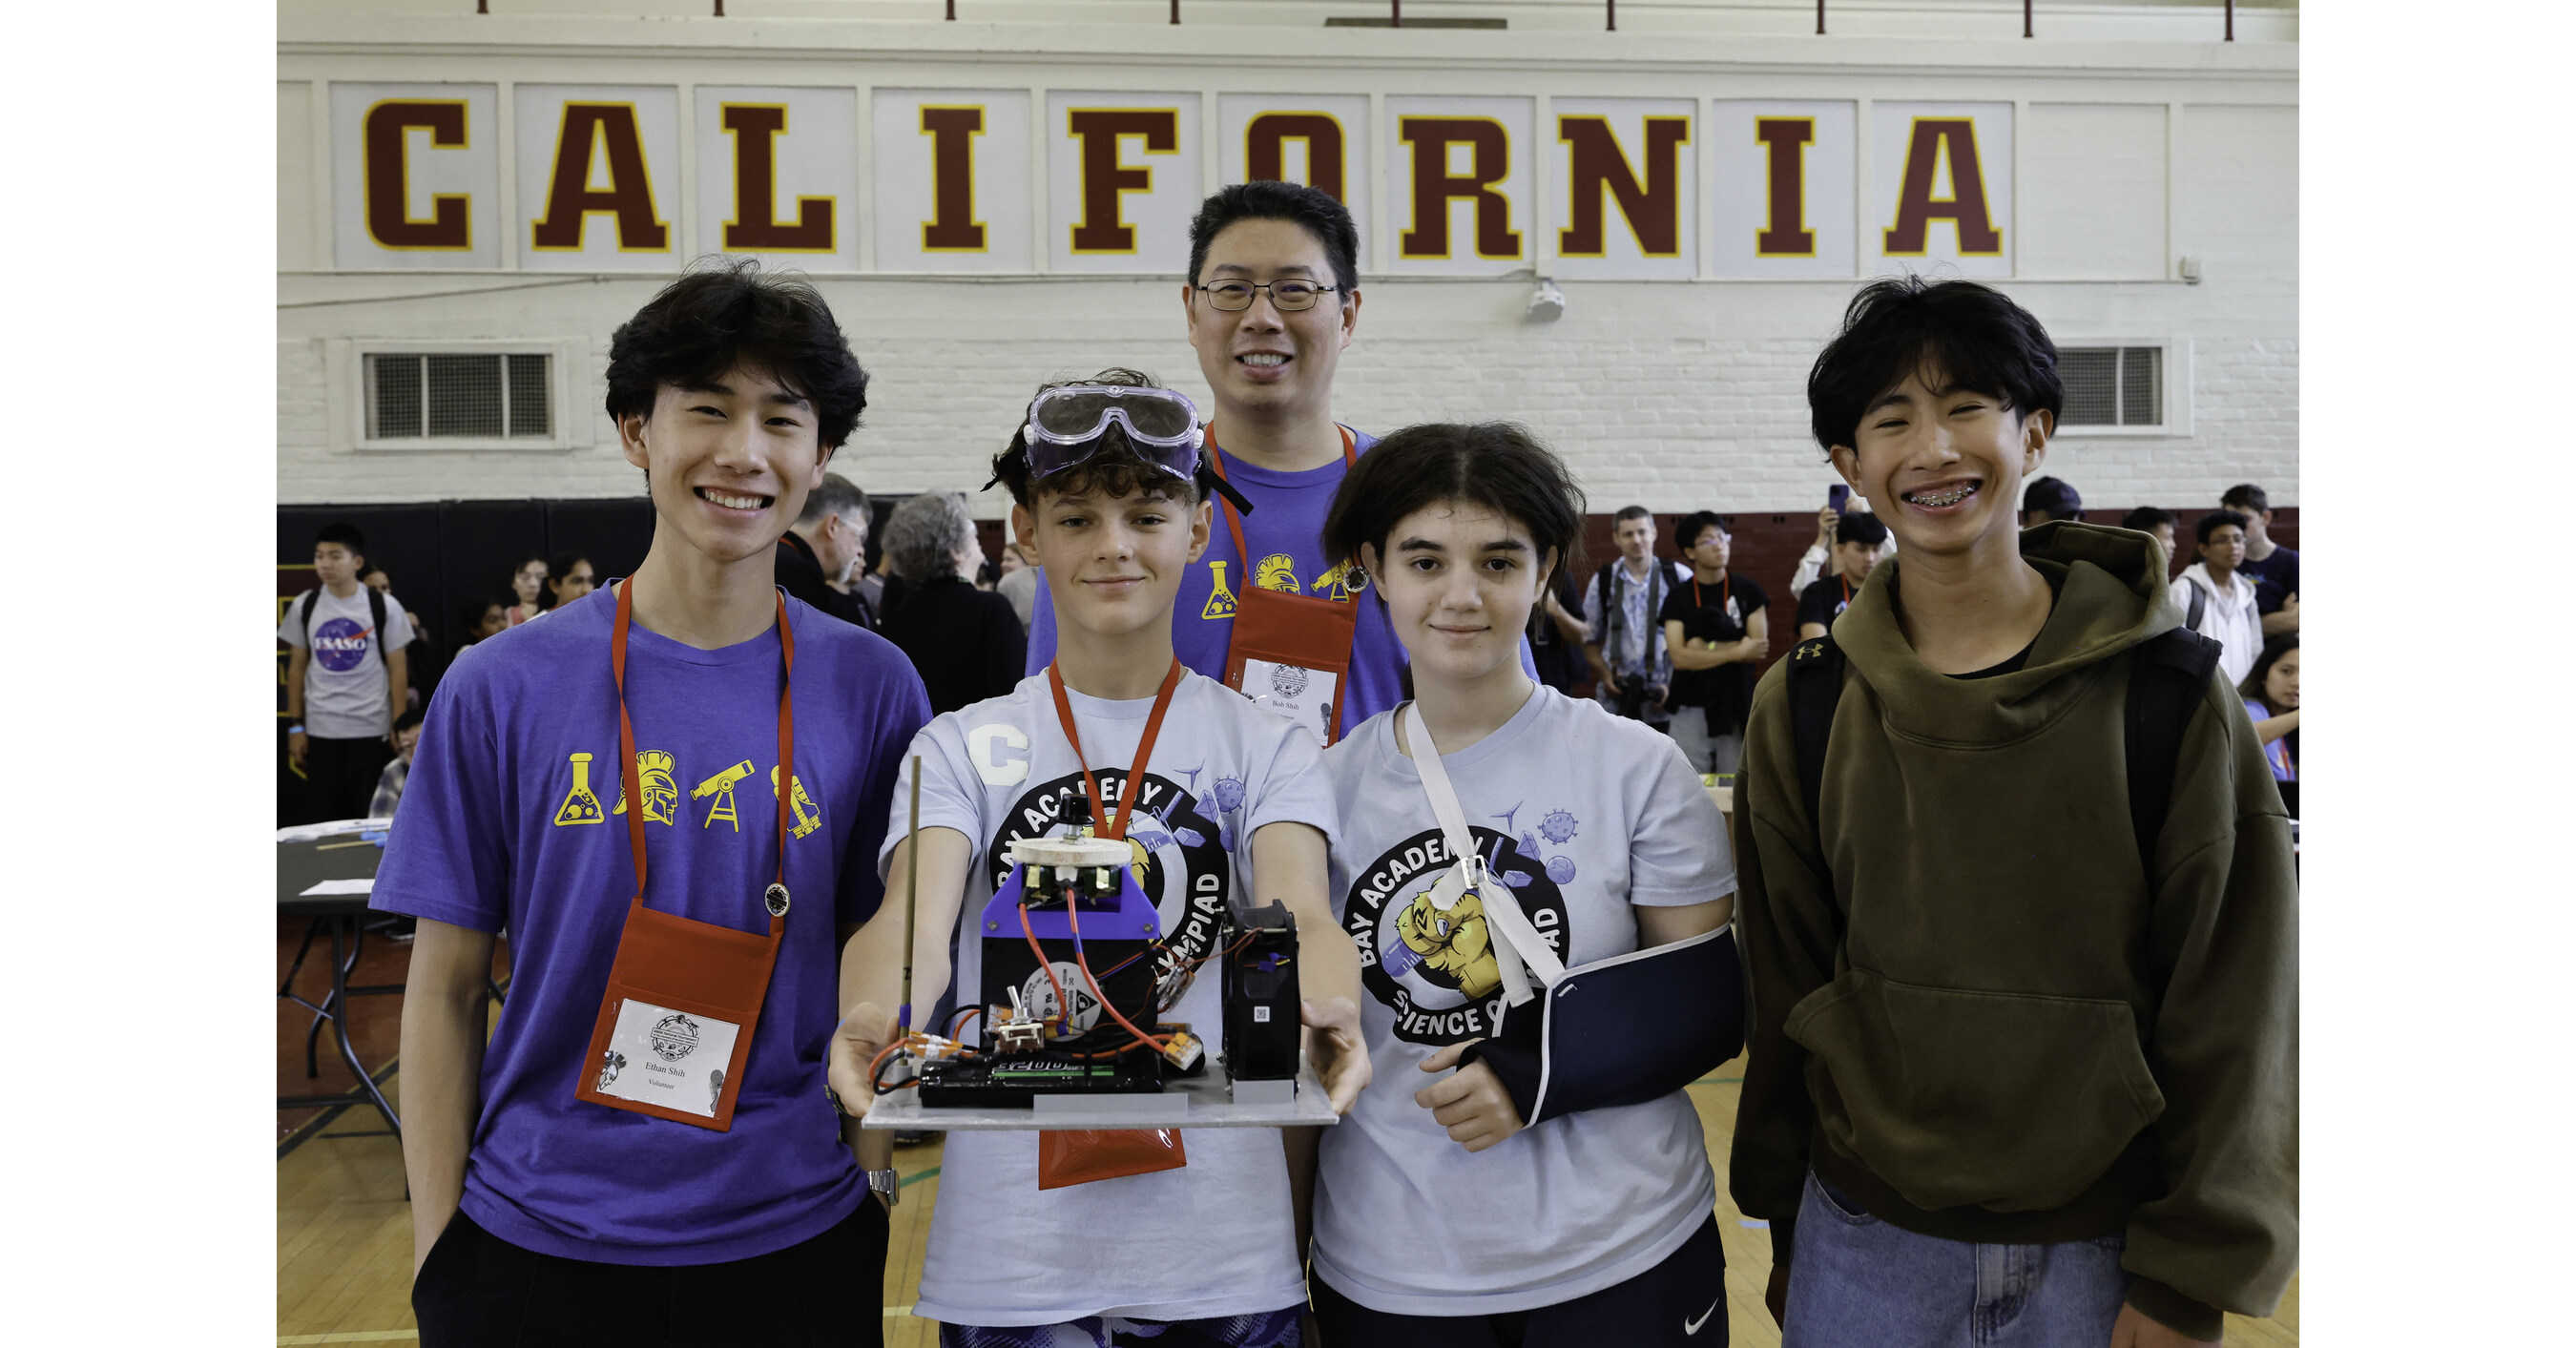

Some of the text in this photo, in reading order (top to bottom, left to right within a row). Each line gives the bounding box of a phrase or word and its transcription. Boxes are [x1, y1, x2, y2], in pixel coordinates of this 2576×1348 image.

[968, 723, 1029, 787] C
[645, 1062, 686, 1078] Ethan Shih
